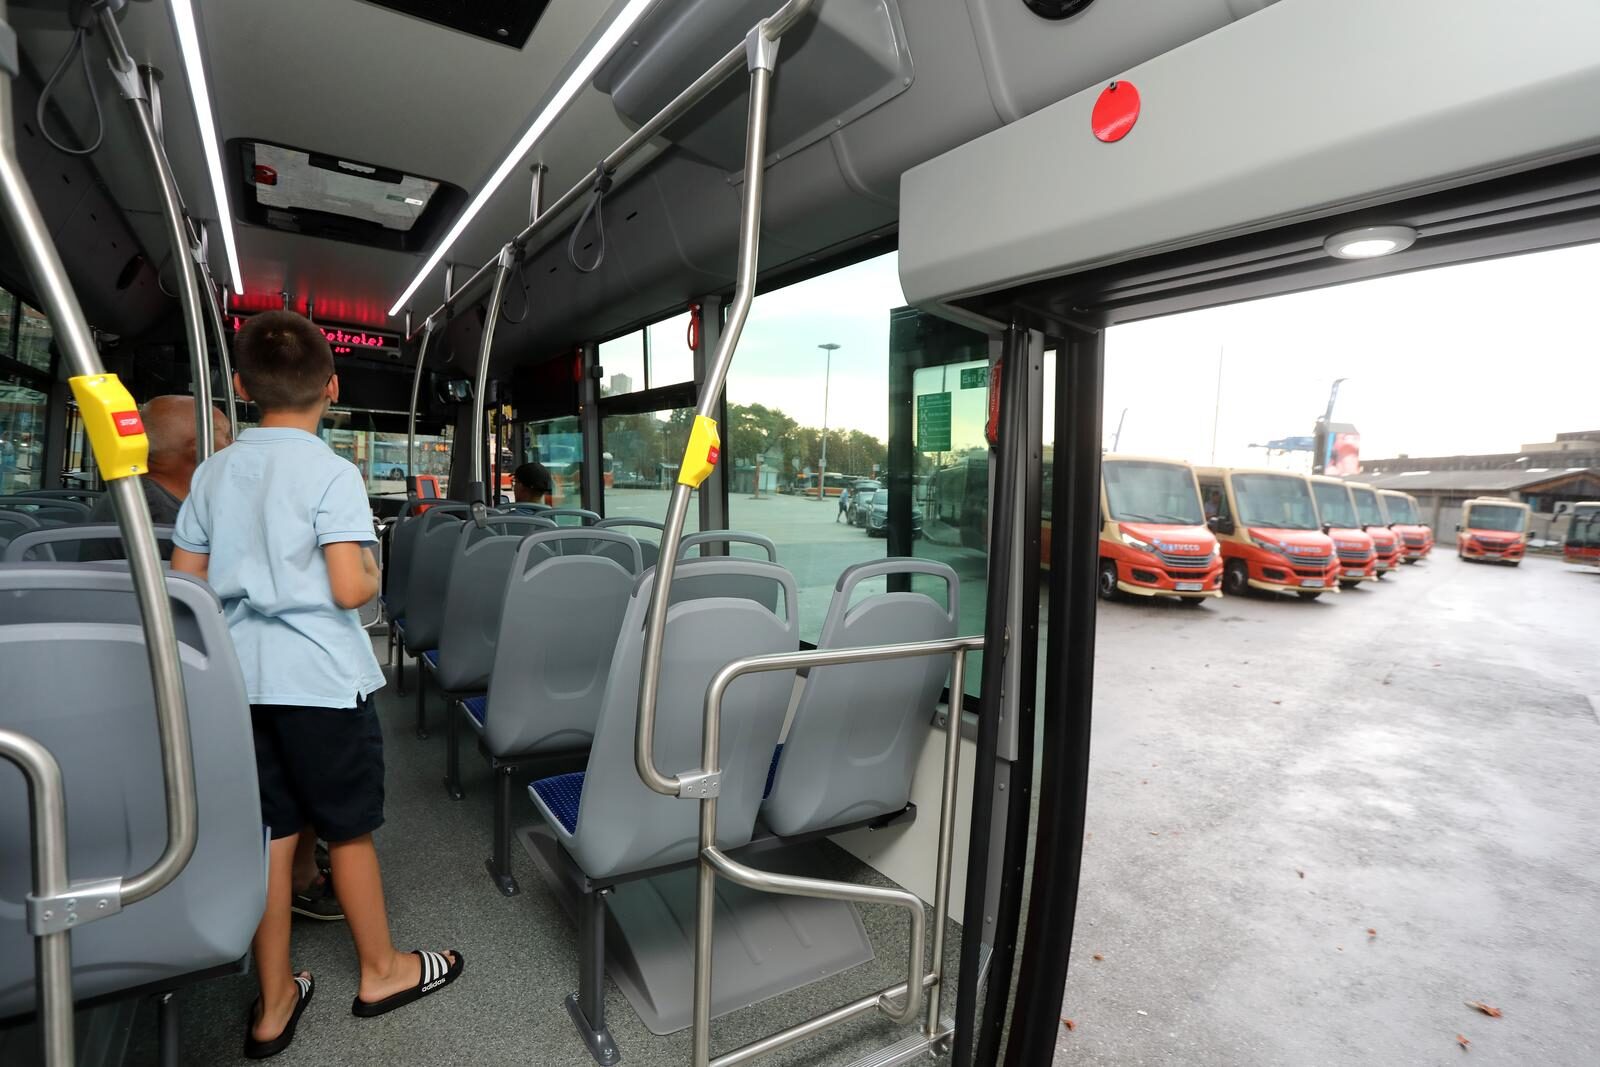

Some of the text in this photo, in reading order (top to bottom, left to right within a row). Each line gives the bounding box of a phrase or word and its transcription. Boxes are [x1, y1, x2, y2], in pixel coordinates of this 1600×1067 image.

[120, 418, 138, 426] STOP
[1174, 543, 1201, 552] IVECO
[421, 977, 446, 993] adidas
